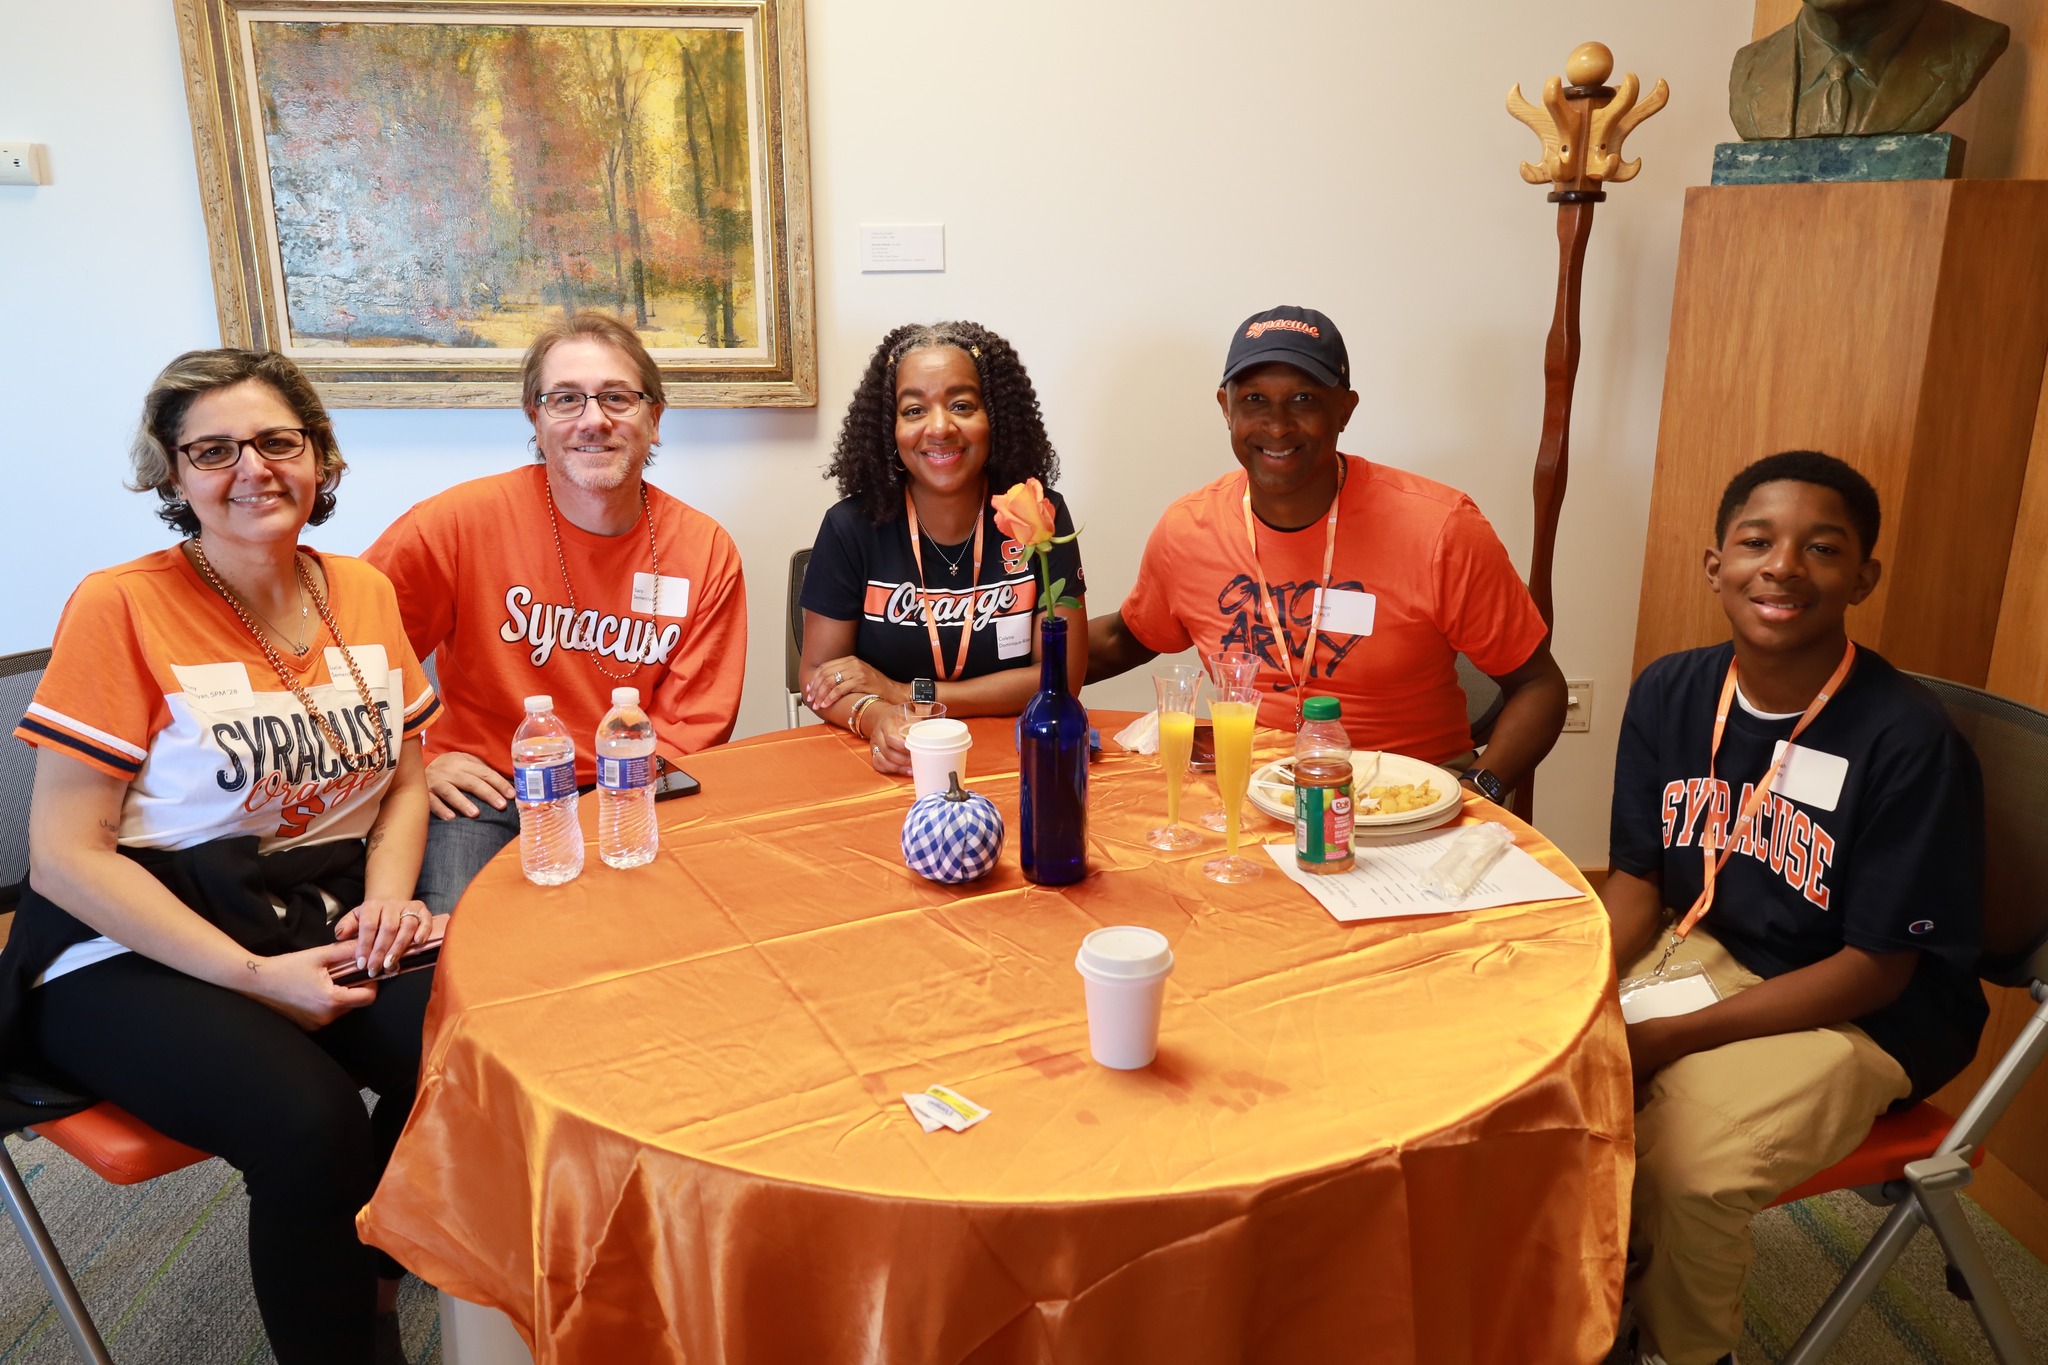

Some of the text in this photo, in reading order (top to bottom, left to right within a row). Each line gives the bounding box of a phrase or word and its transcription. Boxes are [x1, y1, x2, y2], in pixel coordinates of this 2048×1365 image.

[1245, 319, 1320, 338] Syracuse
[500, 585, 681, 667] Syracuse
[886, 581, 1017, 632] Orange
[1219, 610, 1364, 678] ARMY
[212, 701, 397, 793] SYRACUSE
[244, 770, 382, 813] Orange
[275, 795, 325, 838] S
[1662, 778, 1836, 911] SYRACUSE
